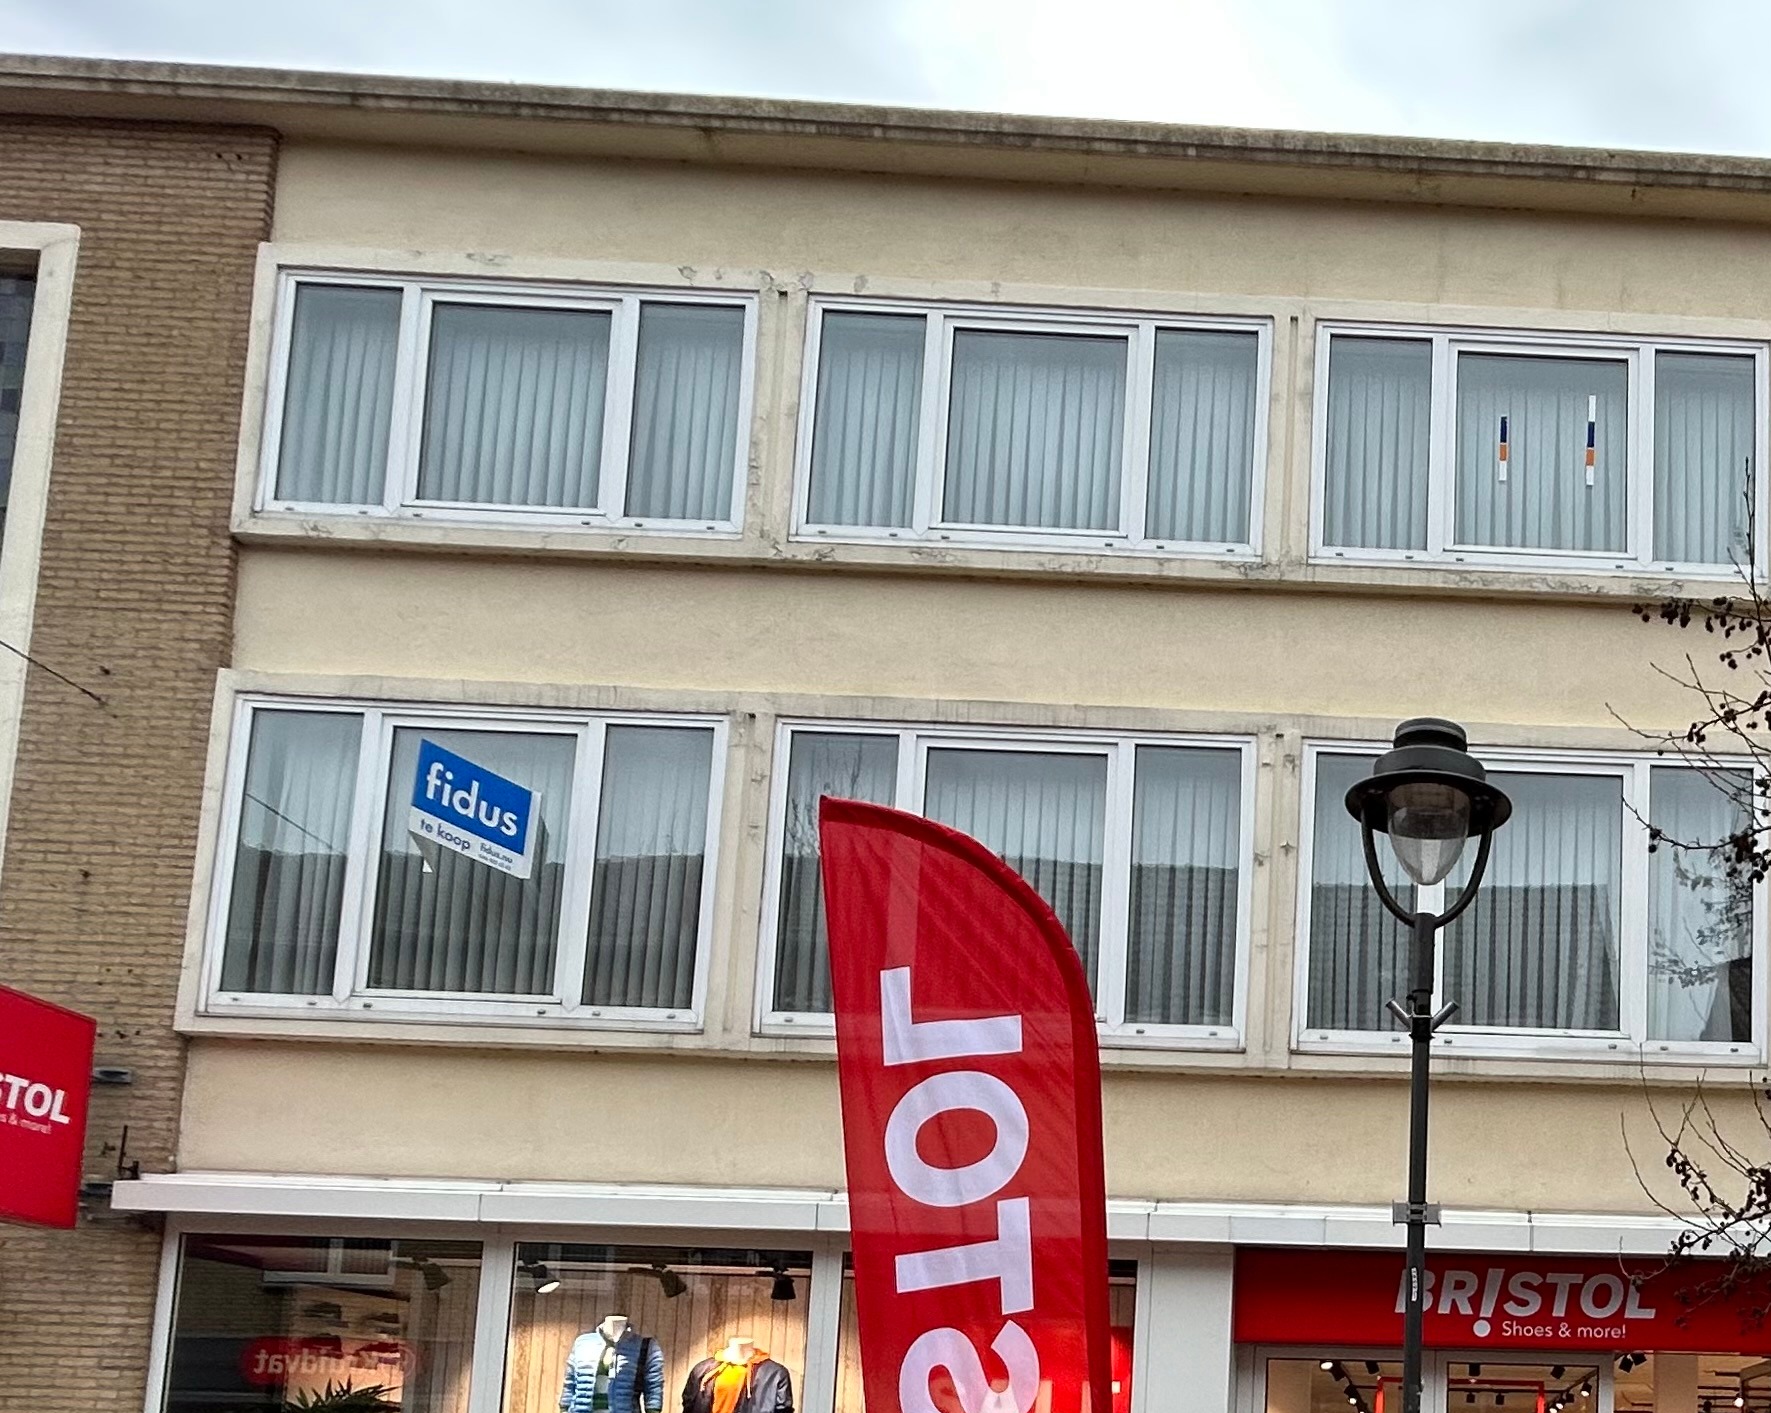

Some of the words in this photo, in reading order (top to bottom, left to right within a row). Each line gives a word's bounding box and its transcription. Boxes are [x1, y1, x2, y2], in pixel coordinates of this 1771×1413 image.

[426, 762, 518, 837] fidus
[420, 819, 433, 833] te
[437, 823, 471, 851] koop
[1502, 1321, 1553, 1338] Shoes
[1558, 1323, 1572, 1338] &
[1577, 1324, 1627, 1339] more!
